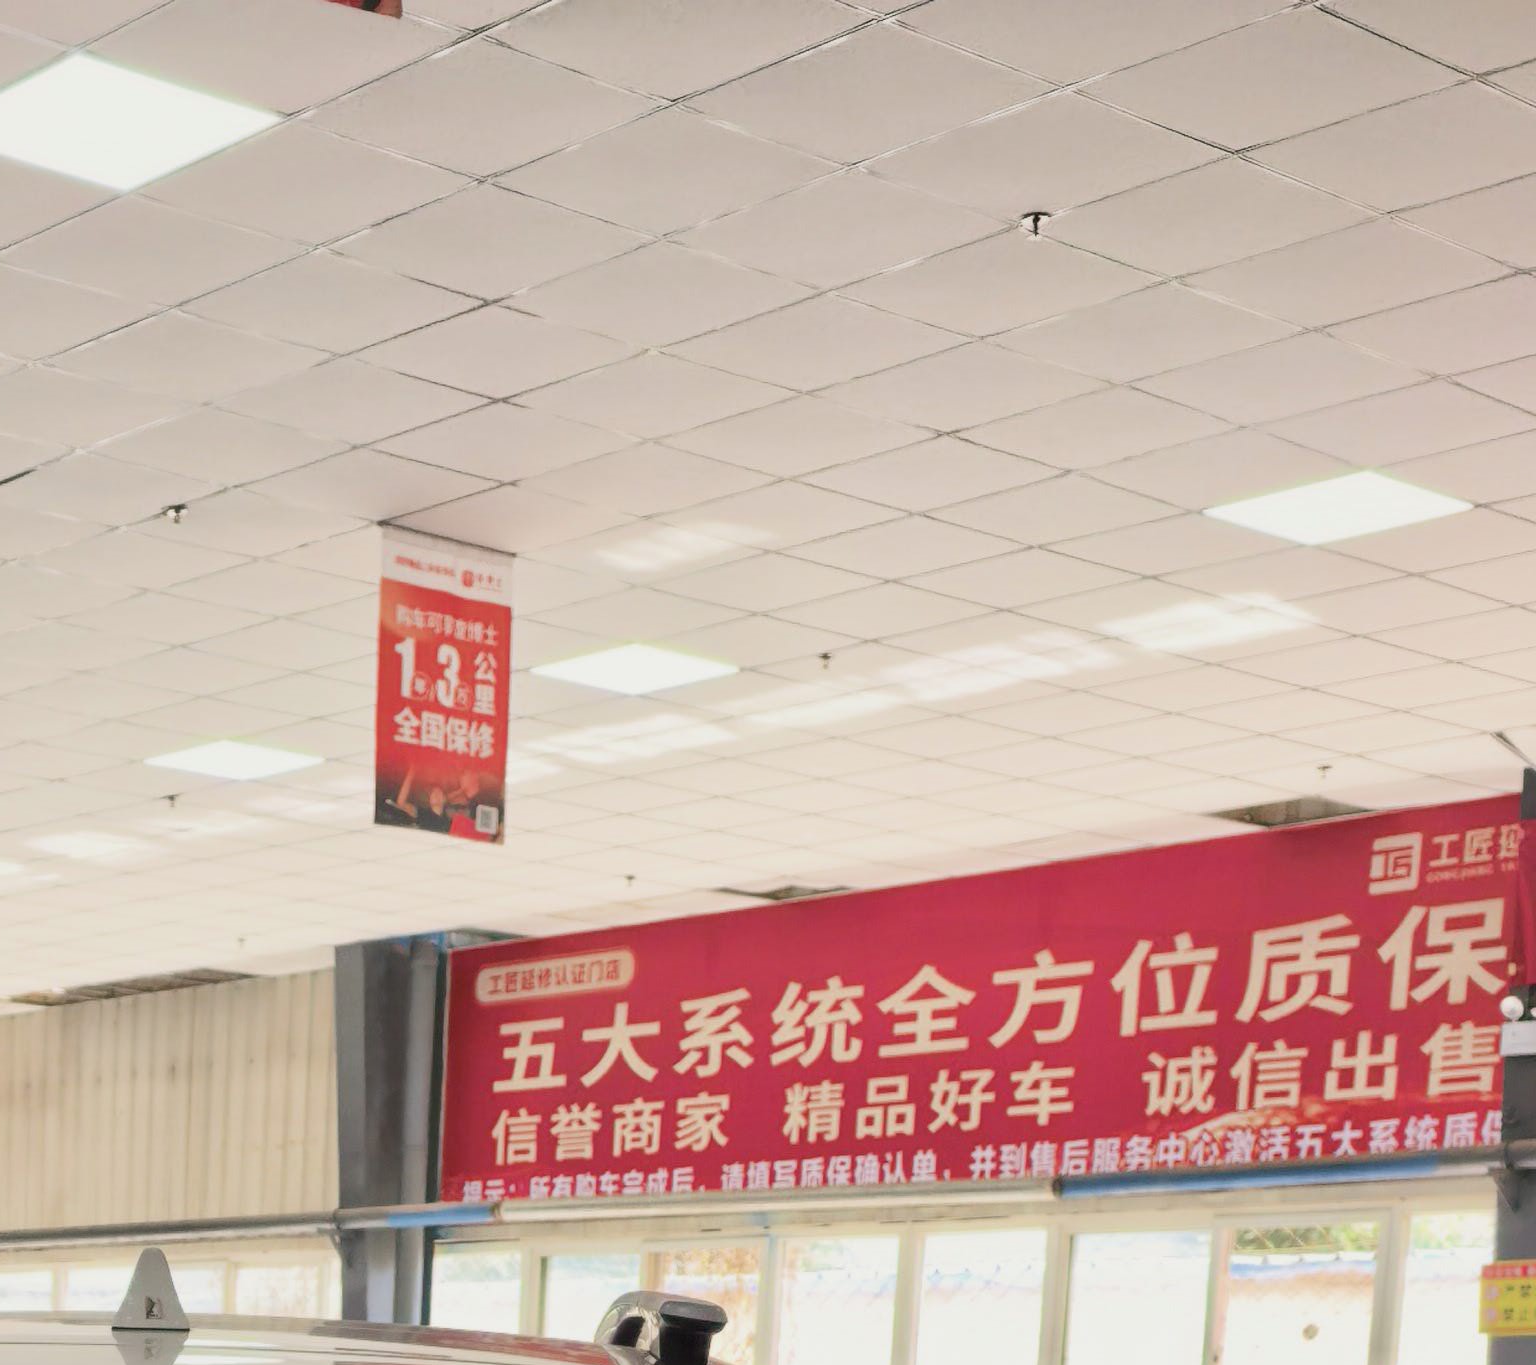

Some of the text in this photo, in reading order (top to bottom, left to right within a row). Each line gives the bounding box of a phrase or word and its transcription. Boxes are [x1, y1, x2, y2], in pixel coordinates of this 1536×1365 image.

[393, 706, 496, 759] 全国保修
[492, 898, 1508, 1094] 五大系统全方位质保
[491, 1019, 1501, 1167] 信誉商家 精品好车 诚信出售
